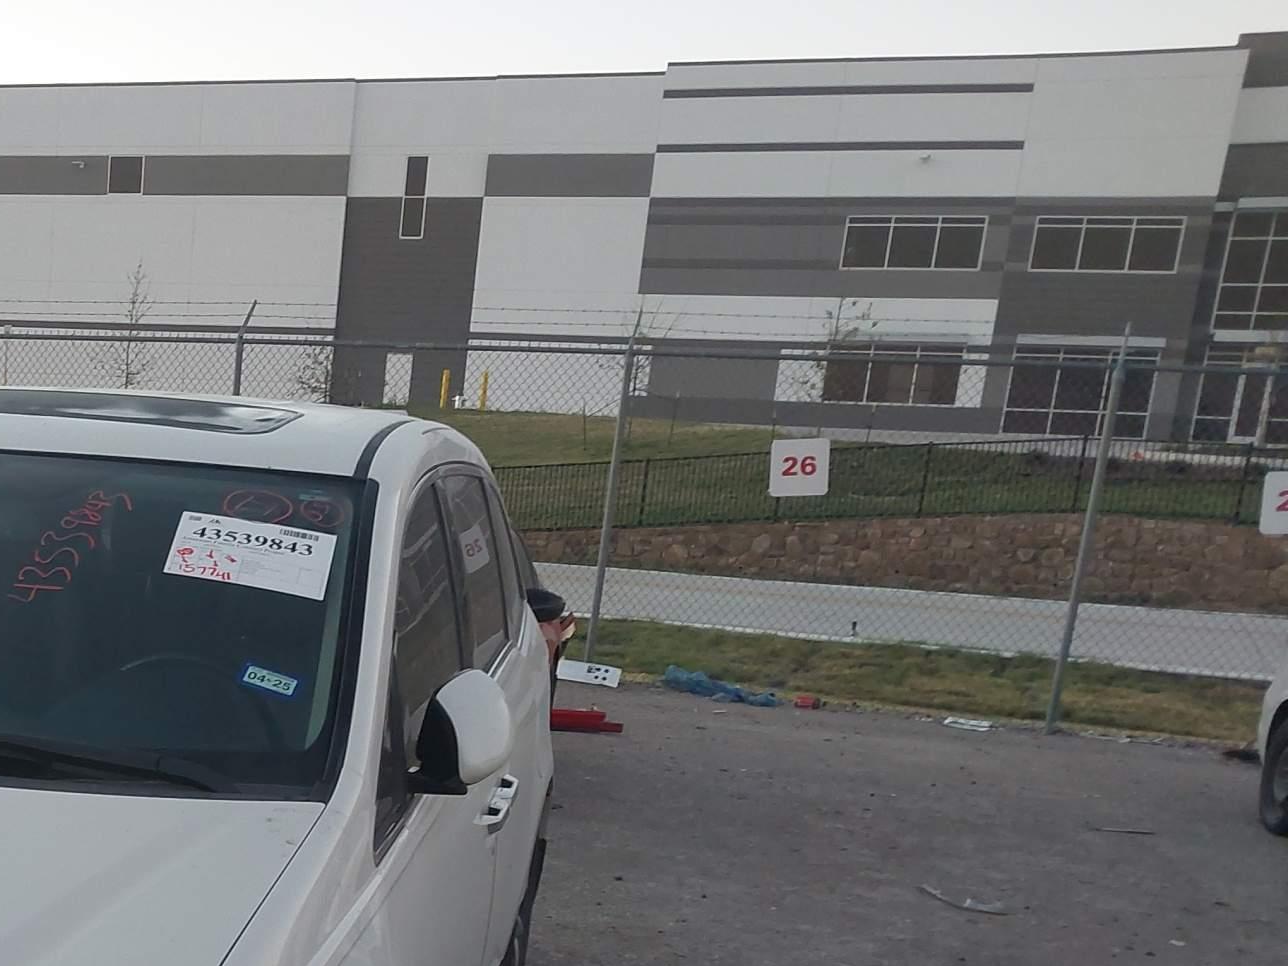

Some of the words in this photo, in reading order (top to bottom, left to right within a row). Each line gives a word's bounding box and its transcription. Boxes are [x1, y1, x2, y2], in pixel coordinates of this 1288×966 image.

[781, 455, 817, 477] 26
[1275, 489, 1288, 512] 2
[192, 527, 313, 557] 43539843
